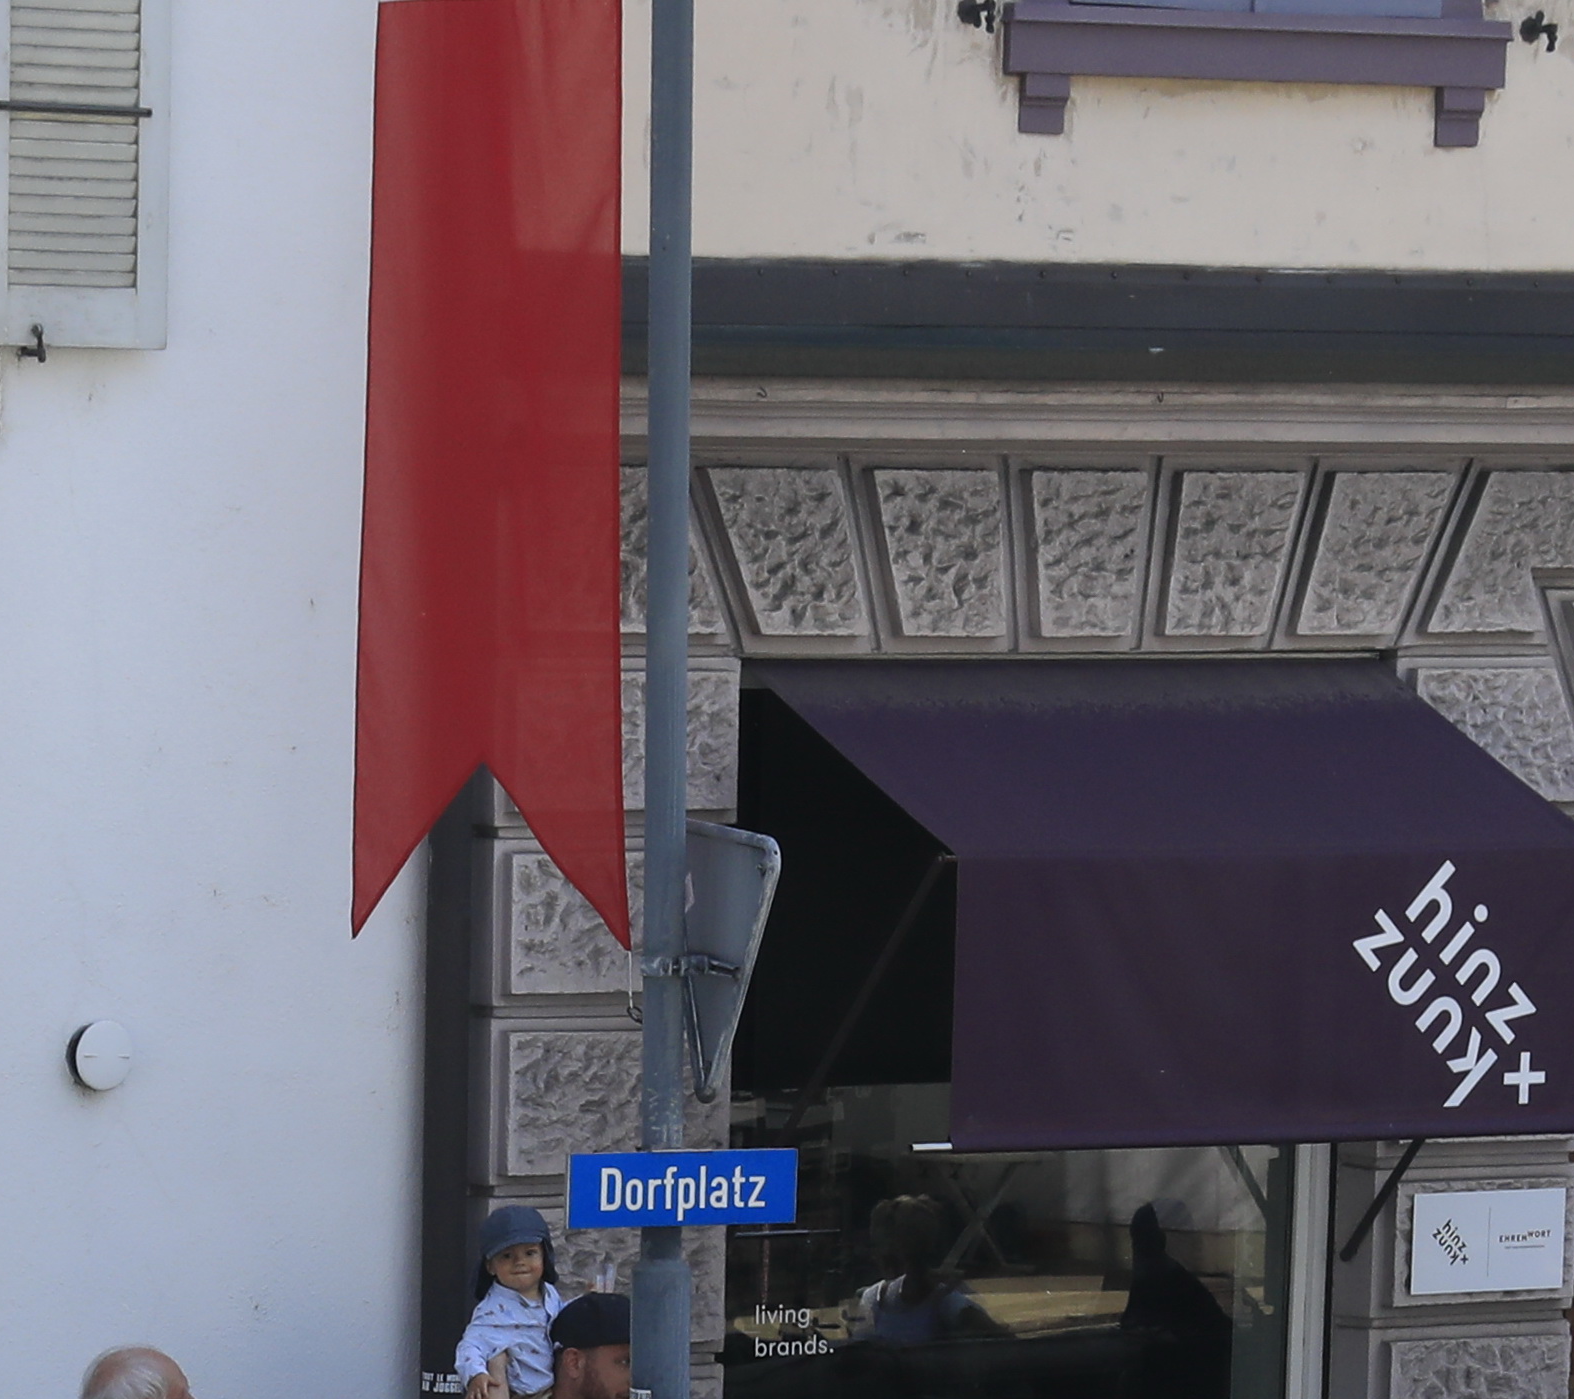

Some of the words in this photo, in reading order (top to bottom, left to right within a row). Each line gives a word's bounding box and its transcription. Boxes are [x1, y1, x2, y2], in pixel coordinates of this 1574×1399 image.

[1404, 859, 1538, 1046] hinz
[599, 1164, 767, 1222] Dorfplatz
[754, 1304, 811, 1328] living
[754, 1334, 835, 1358] brands.
